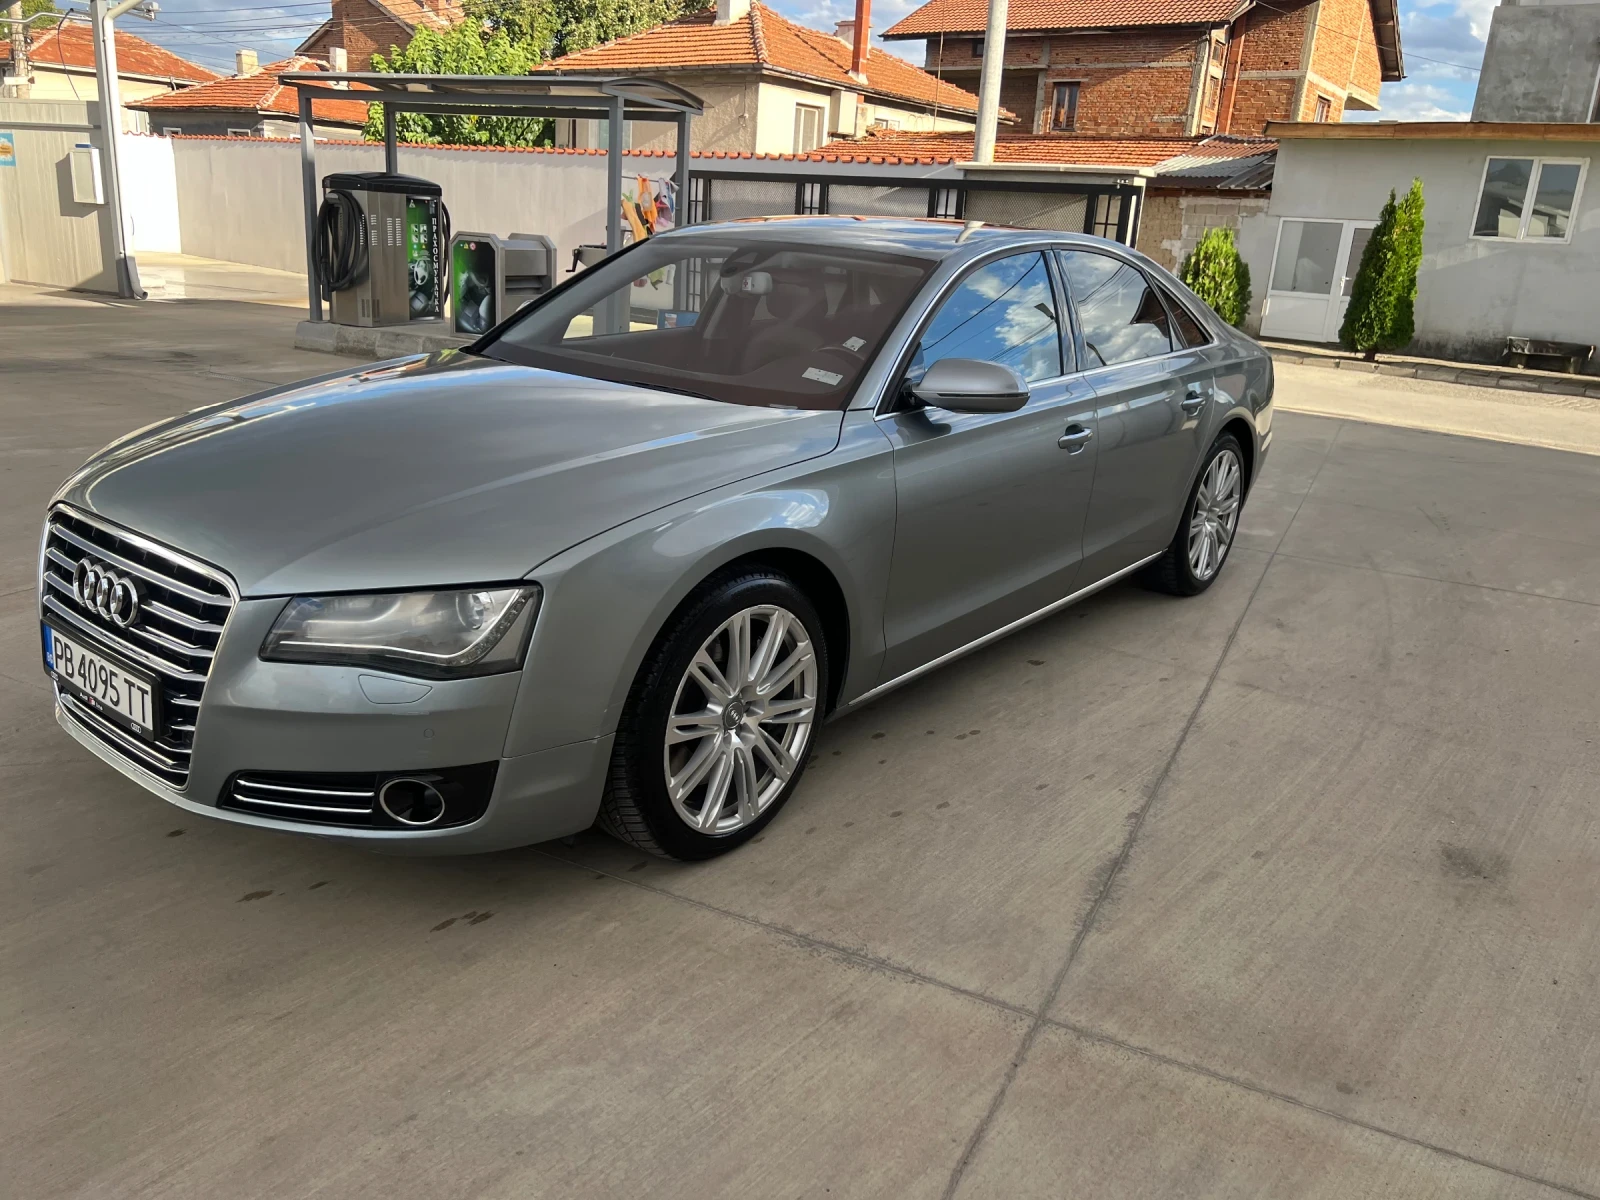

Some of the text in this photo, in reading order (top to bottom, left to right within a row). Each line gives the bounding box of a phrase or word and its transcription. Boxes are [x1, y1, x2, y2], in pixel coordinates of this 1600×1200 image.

[53, 635, 149, 724] PB 4095 TT
